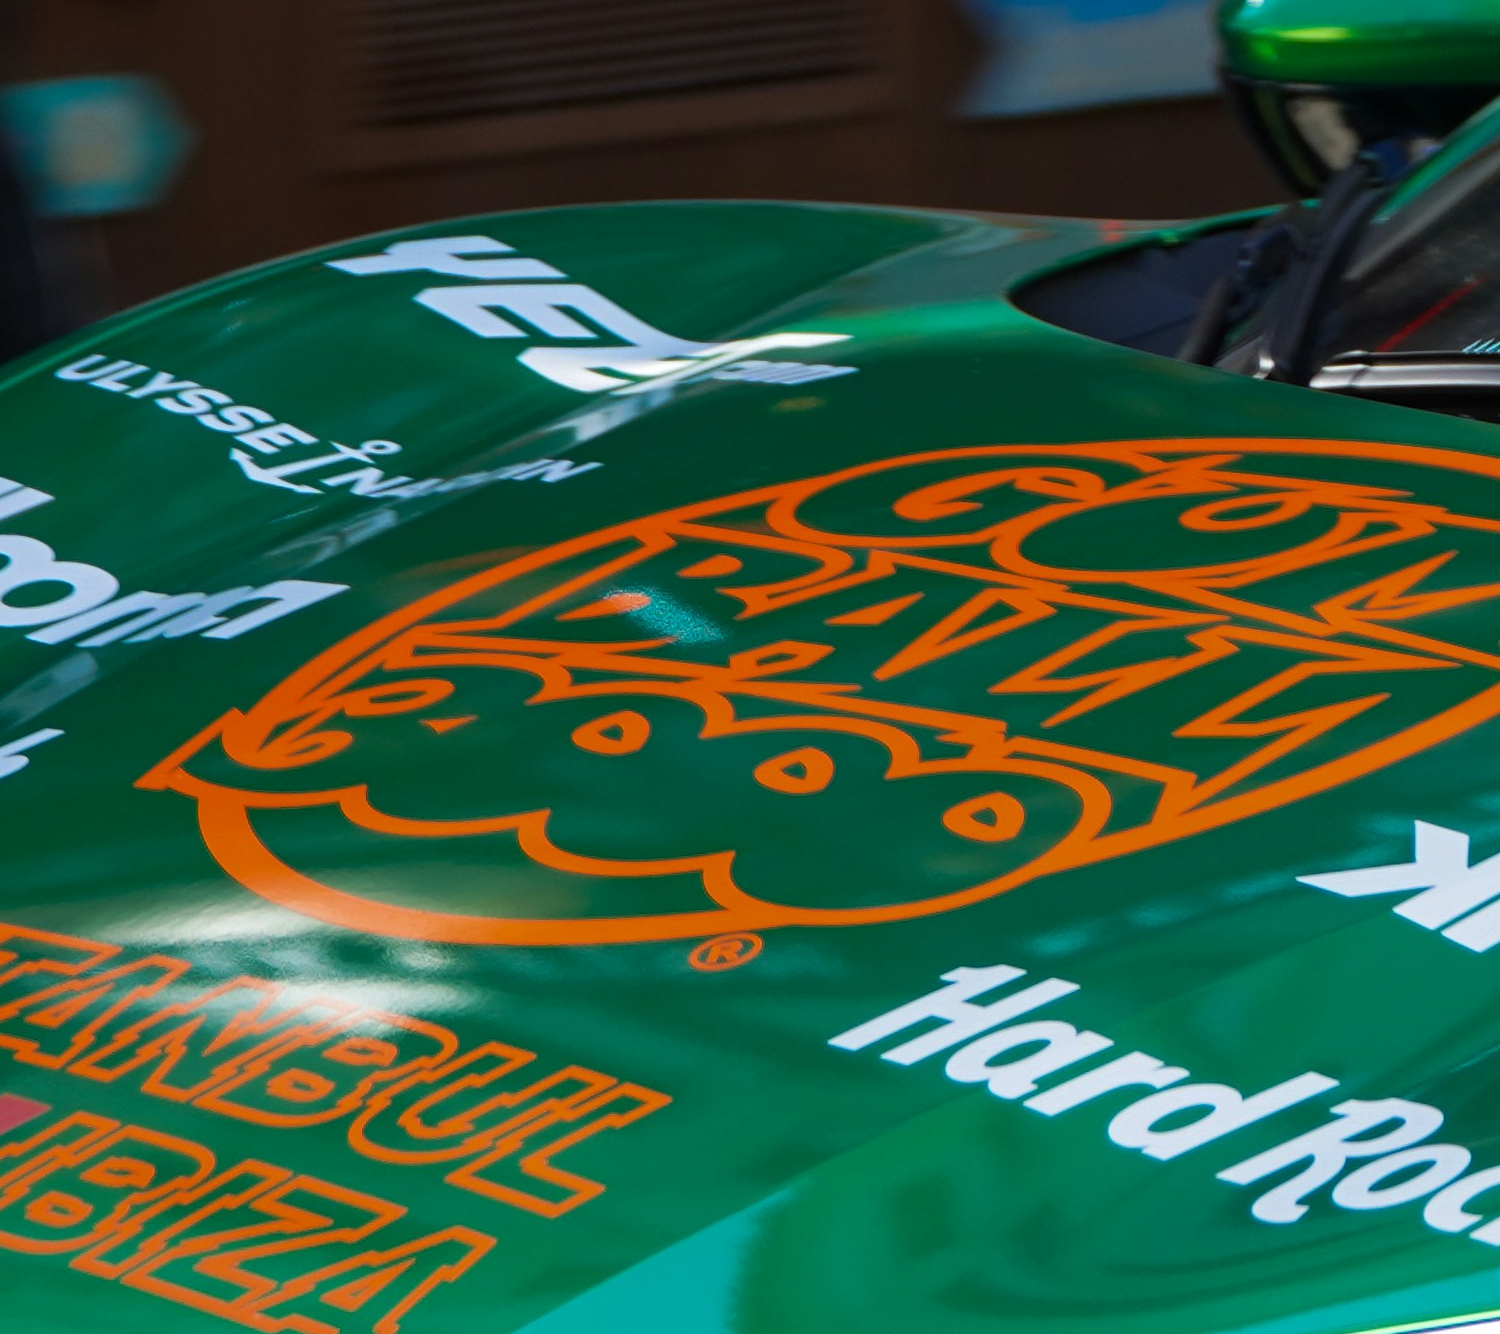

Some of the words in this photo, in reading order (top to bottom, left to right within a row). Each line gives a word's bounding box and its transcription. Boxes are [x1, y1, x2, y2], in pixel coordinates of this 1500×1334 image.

[53, 353, 320, 456] ULYSSE
[318, 458, 605, 500] NAIN
[135, 660, 1112, 919] 3000
[410, 524, 1465, 839] BALL
[827, 962, 1341, 1162] Hard
